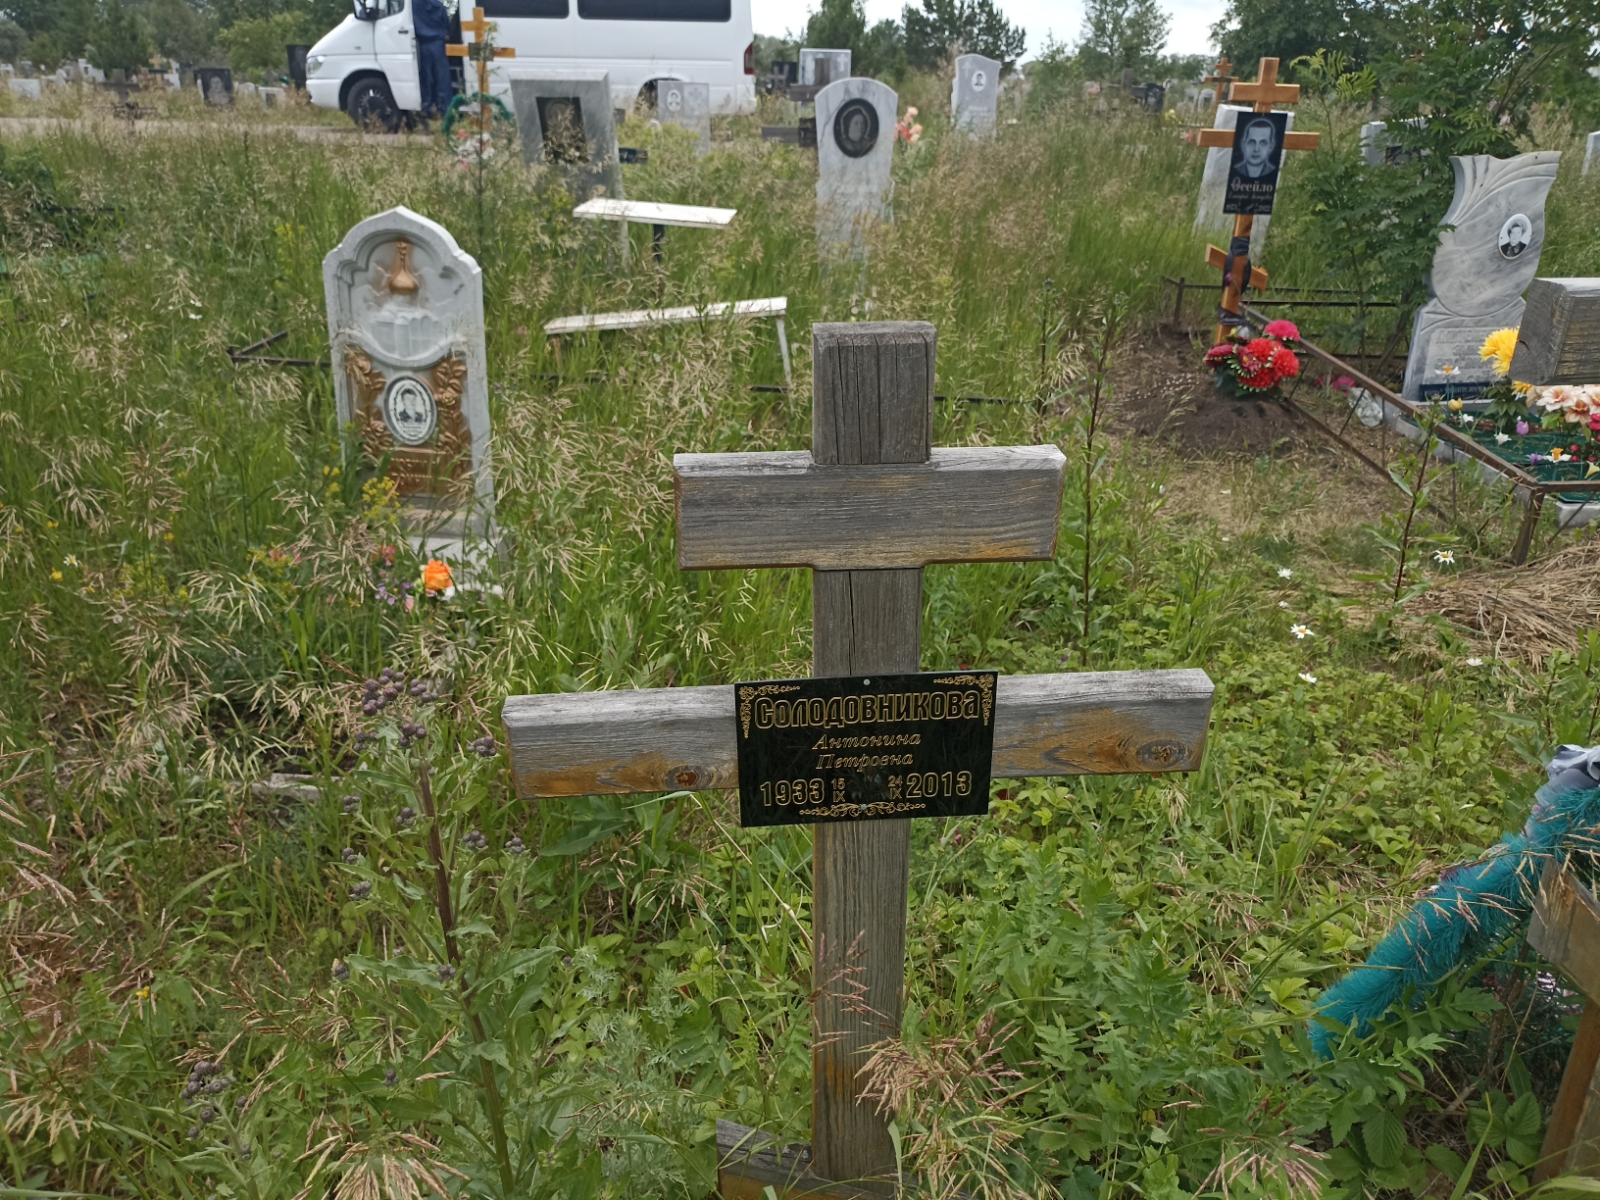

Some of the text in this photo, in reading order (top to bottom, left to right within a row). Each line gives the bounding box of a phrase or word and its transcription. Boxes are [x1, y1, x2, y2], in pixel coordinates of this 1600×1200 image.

[812, 732, 921, 750] Антонина
[815, 752, 914, 773] Петровна
[831, 777, 846, 790] 15
[888, 775, 903, 788] 24
[906, 770, 973, 799] 2013
[760, 778, 825, 807] 1933
[832, 790, 846, 803] IX
[889, 787, 903, 800] IX
